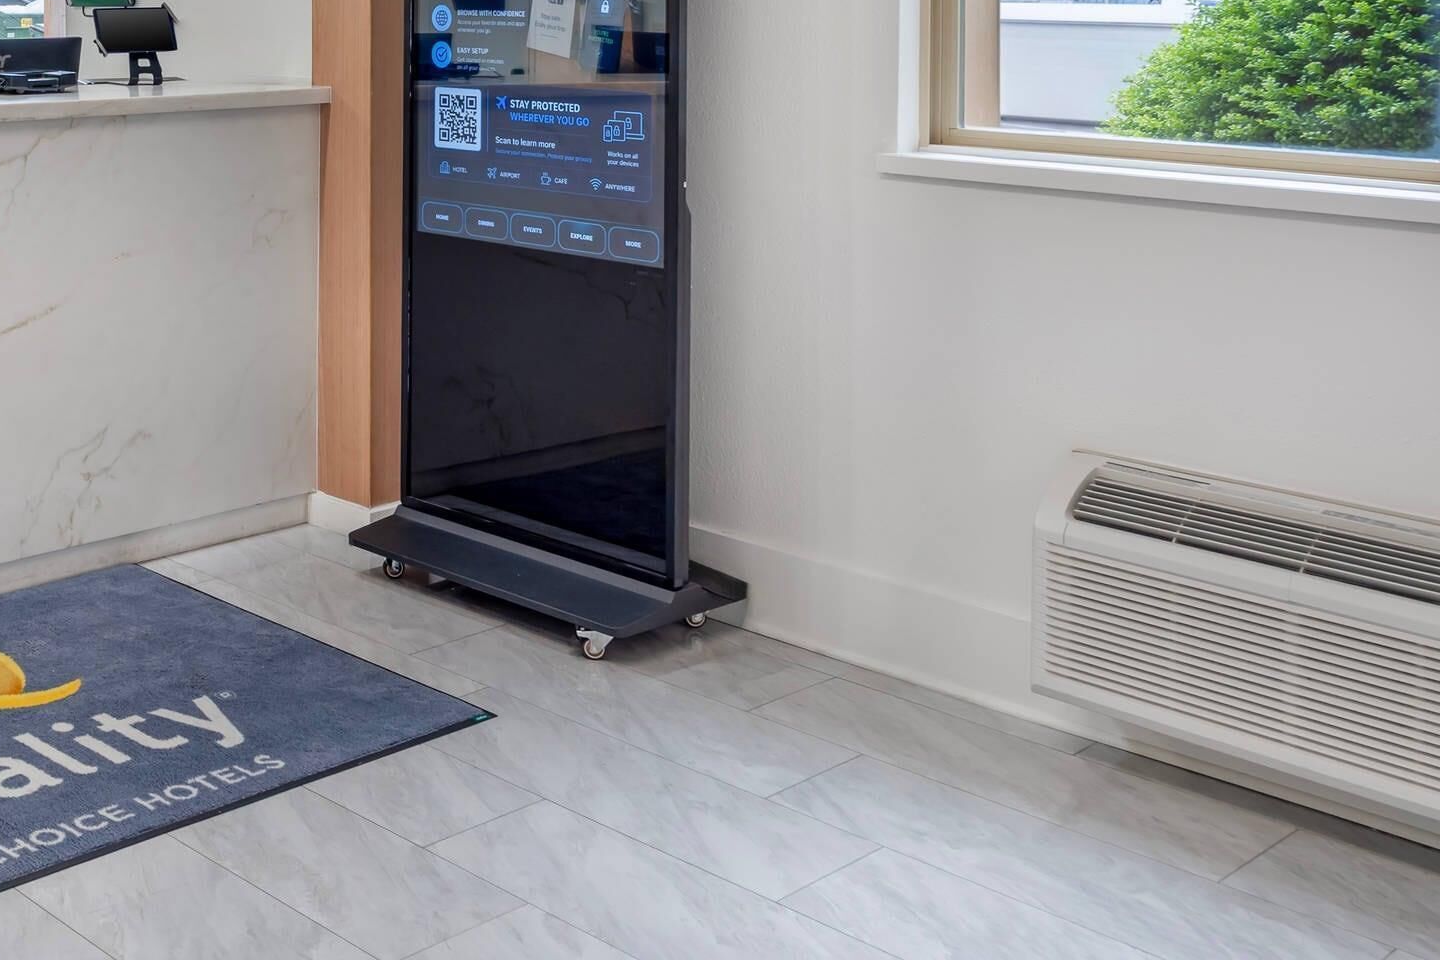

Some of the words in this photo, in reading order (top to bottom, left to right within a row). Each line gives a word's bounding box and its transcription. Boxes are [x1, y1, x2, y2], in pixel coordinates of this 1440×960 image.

[510, 99, 529, 108] STAY
[531, 101, 580, 113] PROTECTED
[510, 112, 554, 124] WHEREVER
[556, 115, 574, 126] YOU
[576, 117, 590, 127] GO
[495, 136, 512, 145] Scan
[520, 137, 537, 147] learn
[538, 141, 556, 149] more
[619, 160, 639, 168] devices
[500, 171, 520, 179] AIRPORT
[605, 183, 635, 193] ANYWHERE
[523, 226, 543, 235] EVENTS
[570, 232, 593, 241] EXPLORE
[625, 240, 641, 248] MORE
[133, 754, 285, 813] HOTELS
